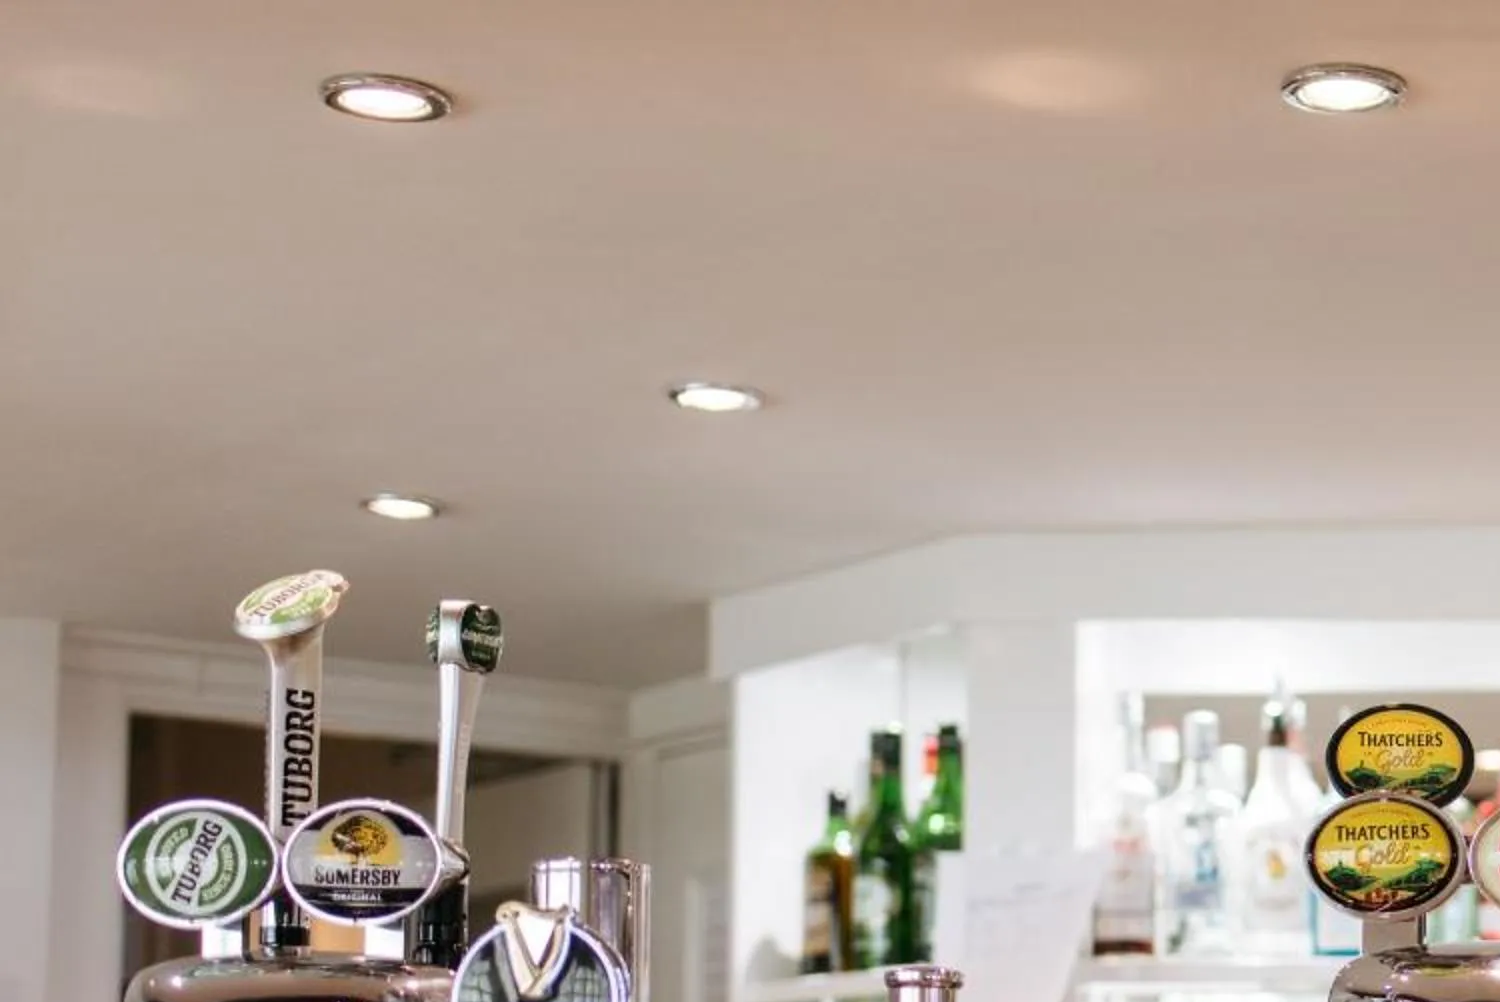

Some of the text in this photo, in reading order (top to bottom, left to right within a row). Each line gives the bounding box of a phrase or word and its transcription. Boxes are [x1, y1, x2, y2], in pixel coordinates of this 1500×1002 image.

[1357, 731, 1443, 747] THATCHERS
[281, 687, 316, 827] TUBORG
[1375, 749, 1424, 771] Gold
[1335, 823, 1431, 841] THATCHERS
[171, 819, 223, 904] TUBORG
